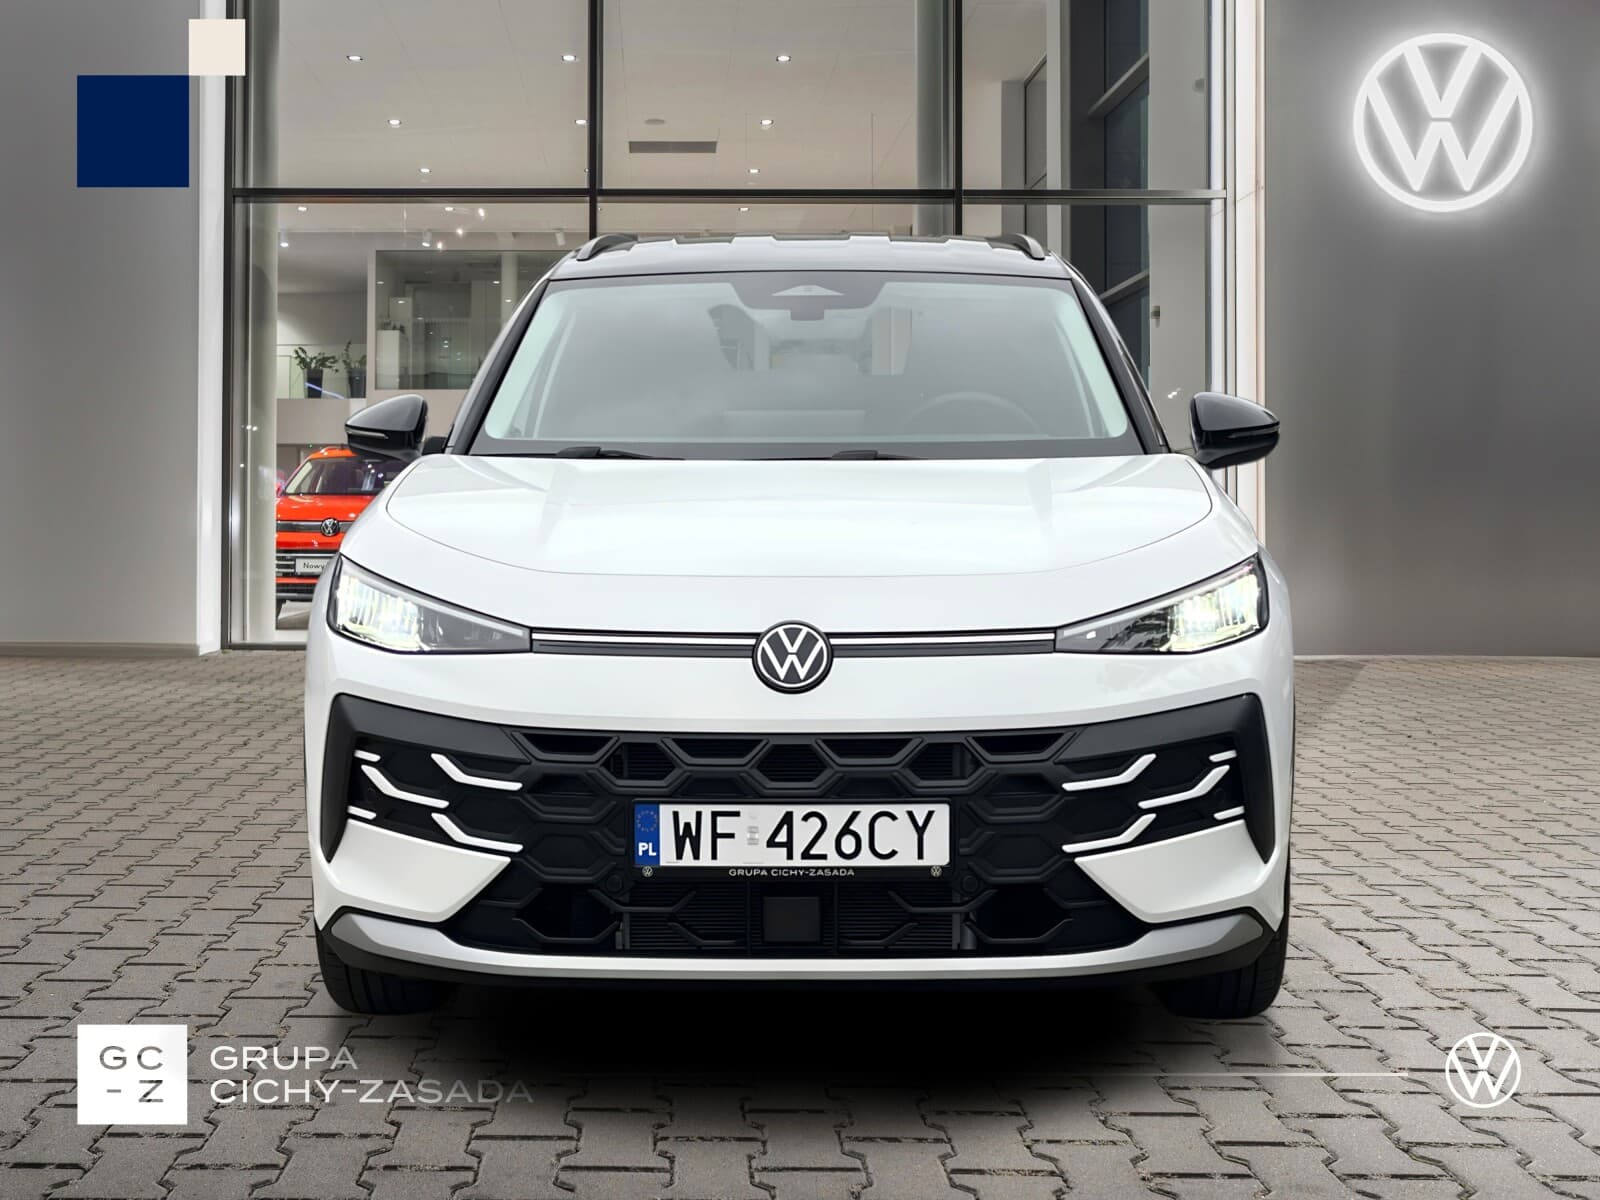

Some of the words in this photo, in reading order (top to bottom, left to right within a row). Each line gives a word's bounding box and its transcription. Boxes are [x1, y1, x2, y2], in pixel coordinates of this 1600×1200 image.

[303, 562, 324, 571] Nowy
[672, 810, 741, 861] WF
[766, 810, 935, 861] 426CY
[638, 842, 657, 856] PL
[728, 868, 768, 877] GRUPA
[771, 868, 855, 877] CICHY-ZASADA
